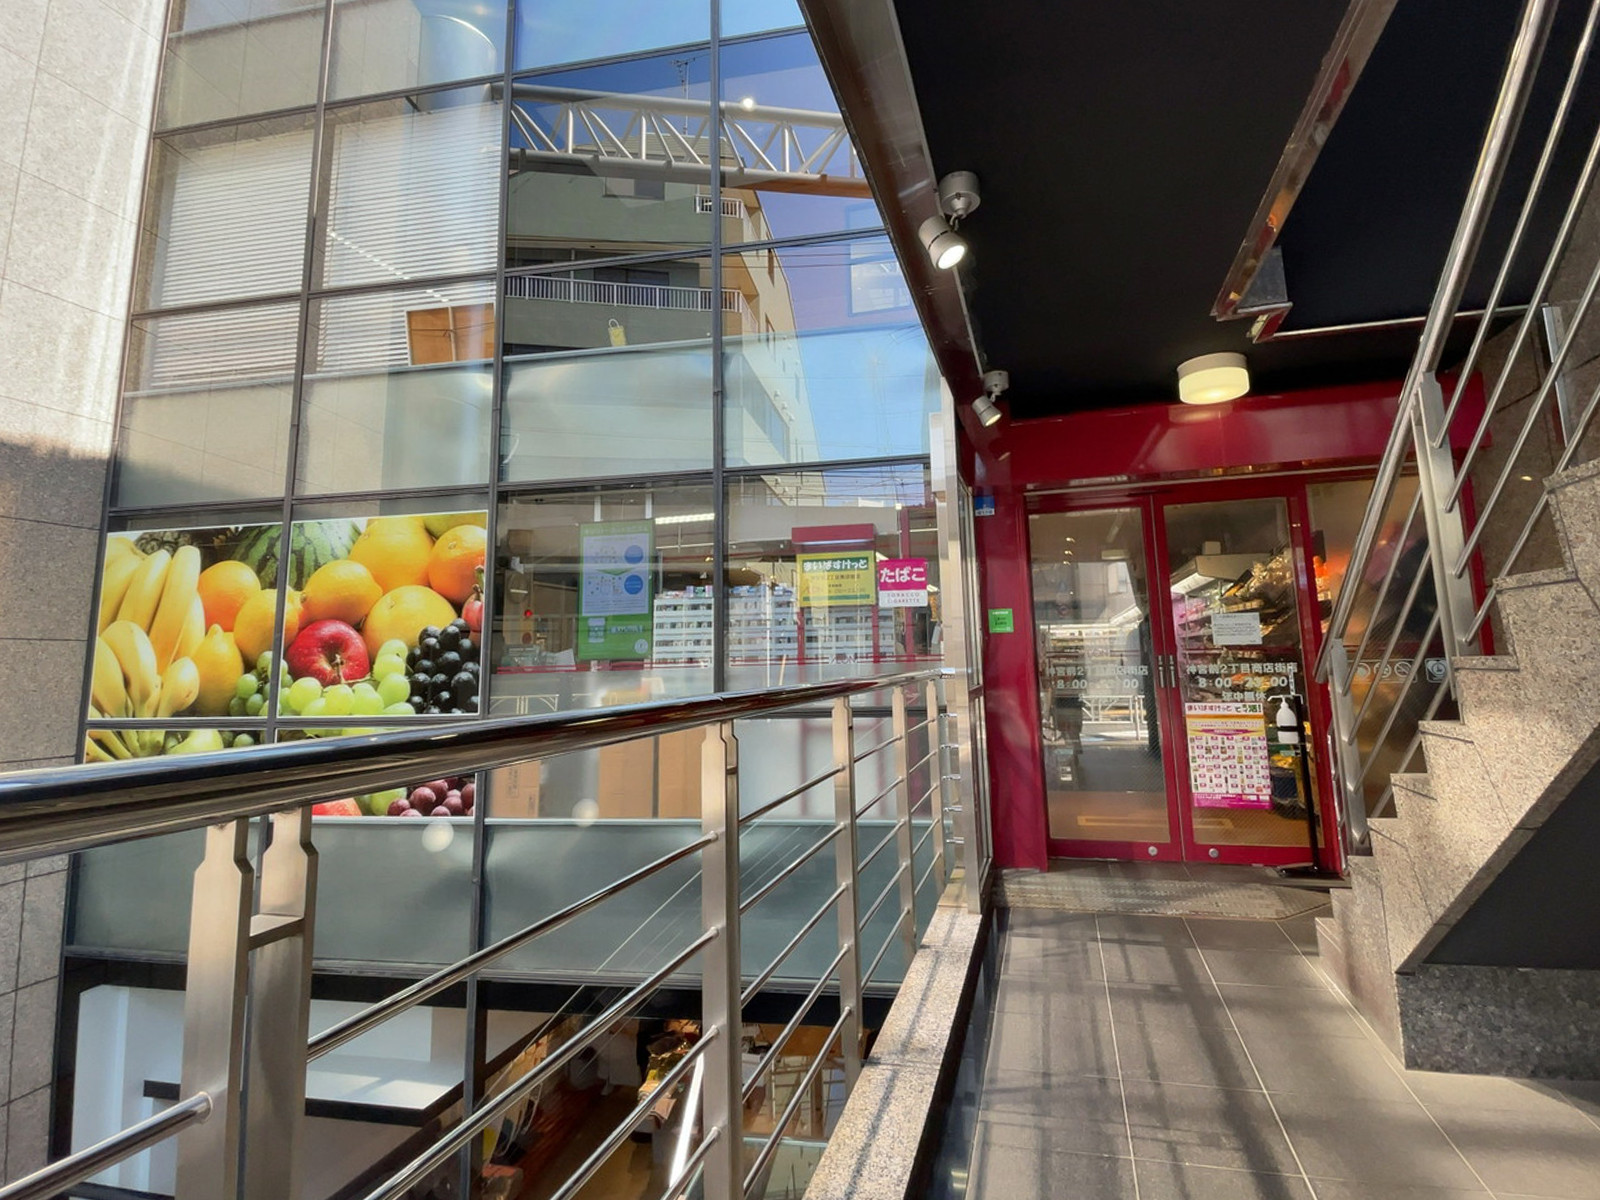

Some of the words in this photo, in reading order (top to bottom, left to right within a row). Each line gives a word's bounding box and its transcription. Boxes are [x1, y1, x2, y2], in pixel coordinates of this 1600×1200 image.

[804, 559, 868, 572] まいばすけっと
[880, 566, 926, 583] たばこ
